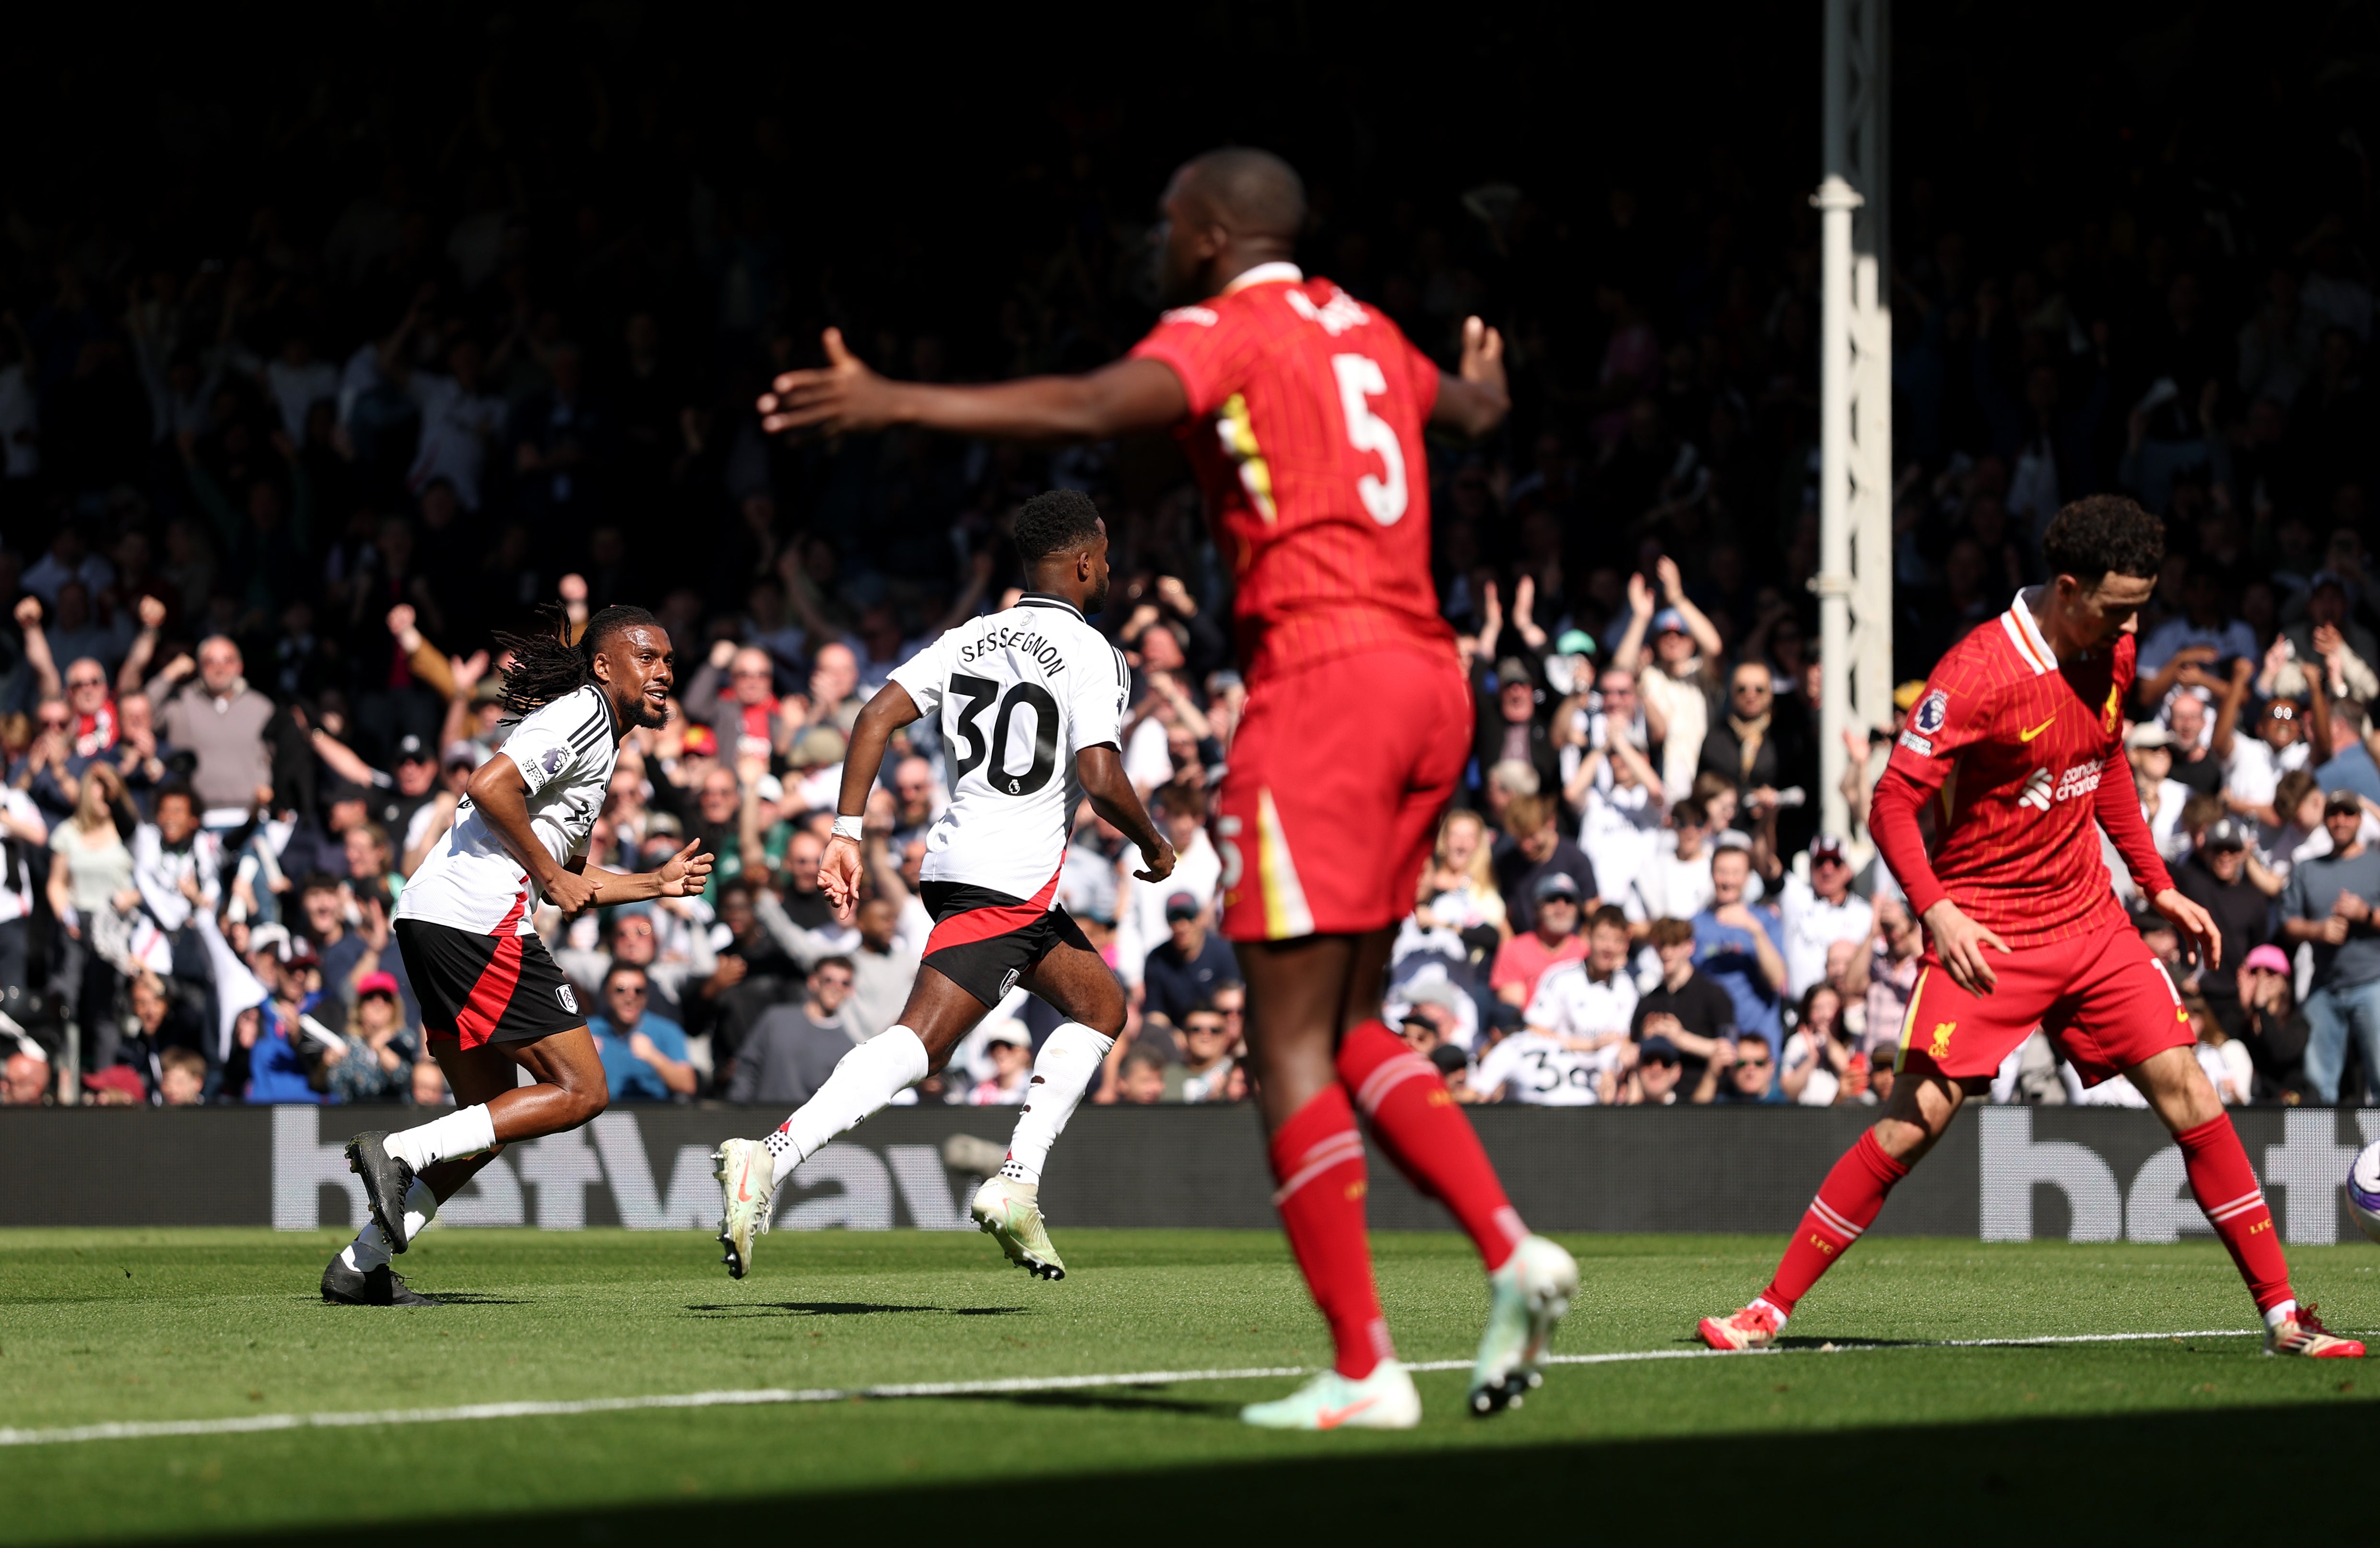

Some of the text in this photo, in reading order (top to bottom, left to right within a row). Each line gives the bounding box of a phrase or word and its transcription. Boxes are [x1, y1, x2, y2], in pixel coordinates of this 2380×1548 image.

[1331, 352, 1409, 527] 5
[961, 627, 1065, 678] SESSEGNON
[949, 672, 1060, 796] 30
[527, 758, 545, 786] No room
[1810, 1233, 1834, 1255] LFC
[2250, 1219, 2272, 1235] LFC
